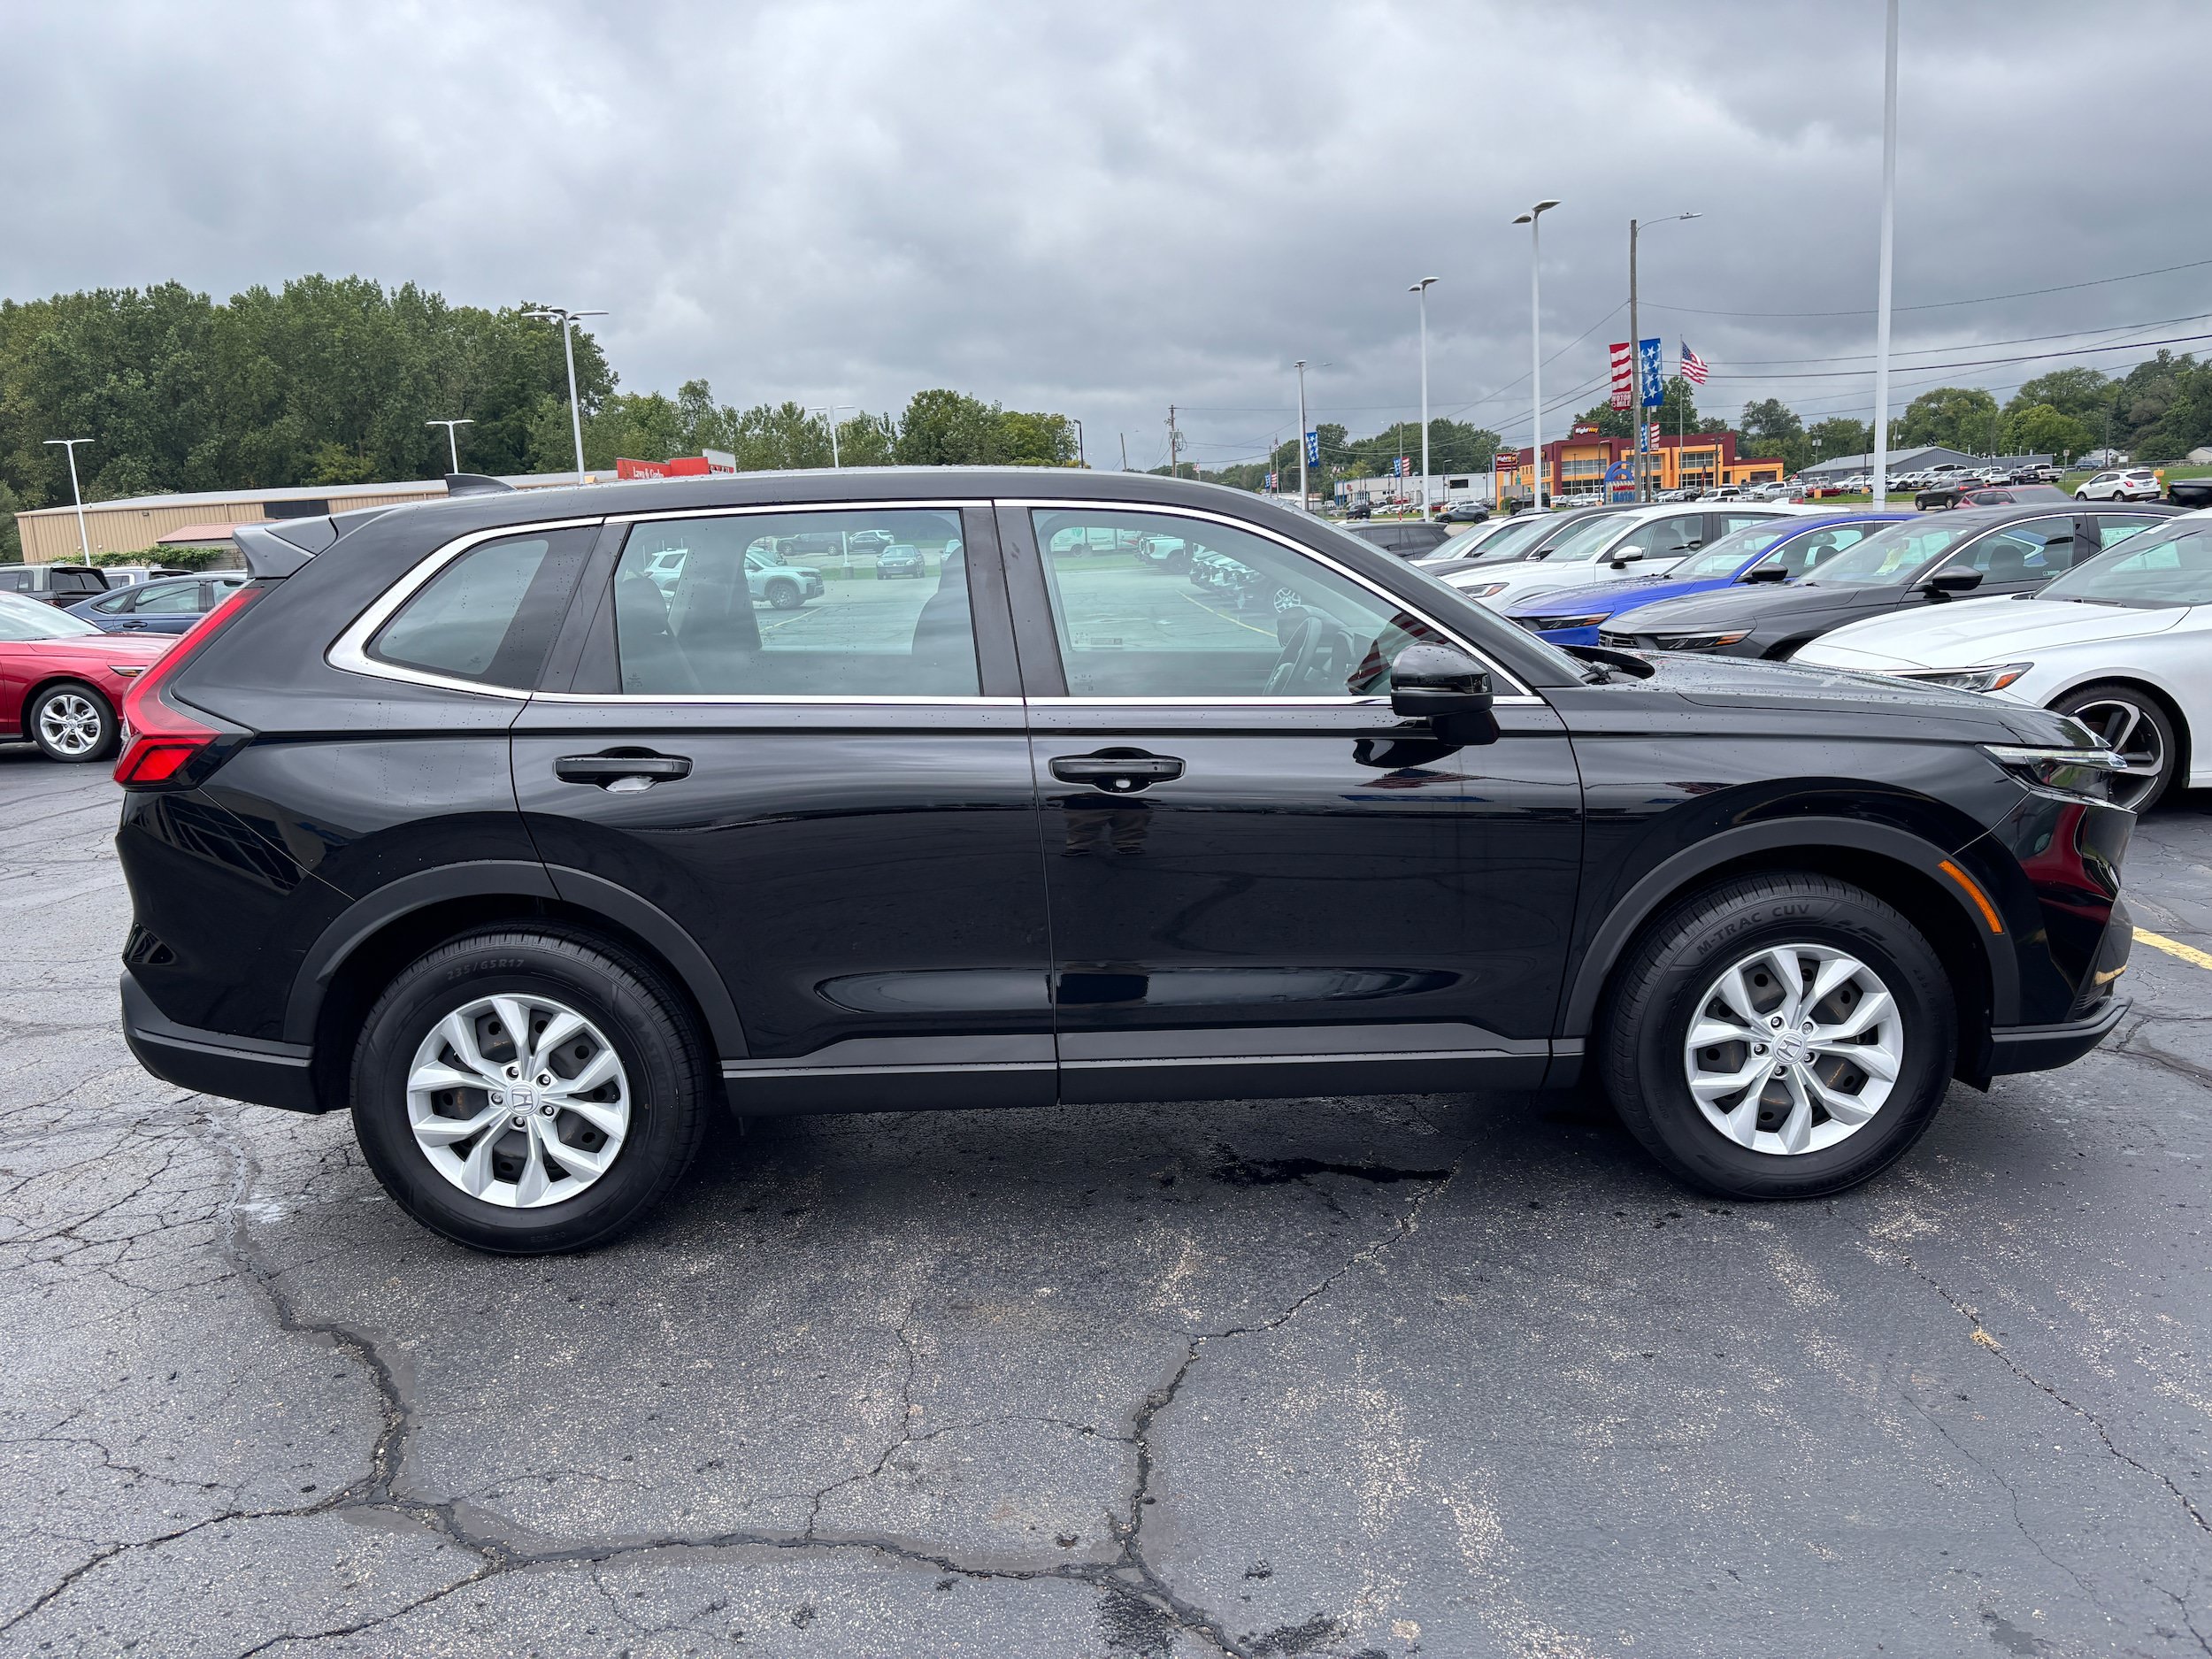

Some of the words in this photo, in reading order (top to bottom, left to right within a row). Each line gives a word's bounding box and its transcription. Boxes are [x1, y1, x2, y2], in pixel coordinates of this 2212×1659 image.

[1696, 912, 1763, 955] M-TRAC
[1772, 904, 1810, 917] CUV
[447, 958, 525, 980] 235/65R17
